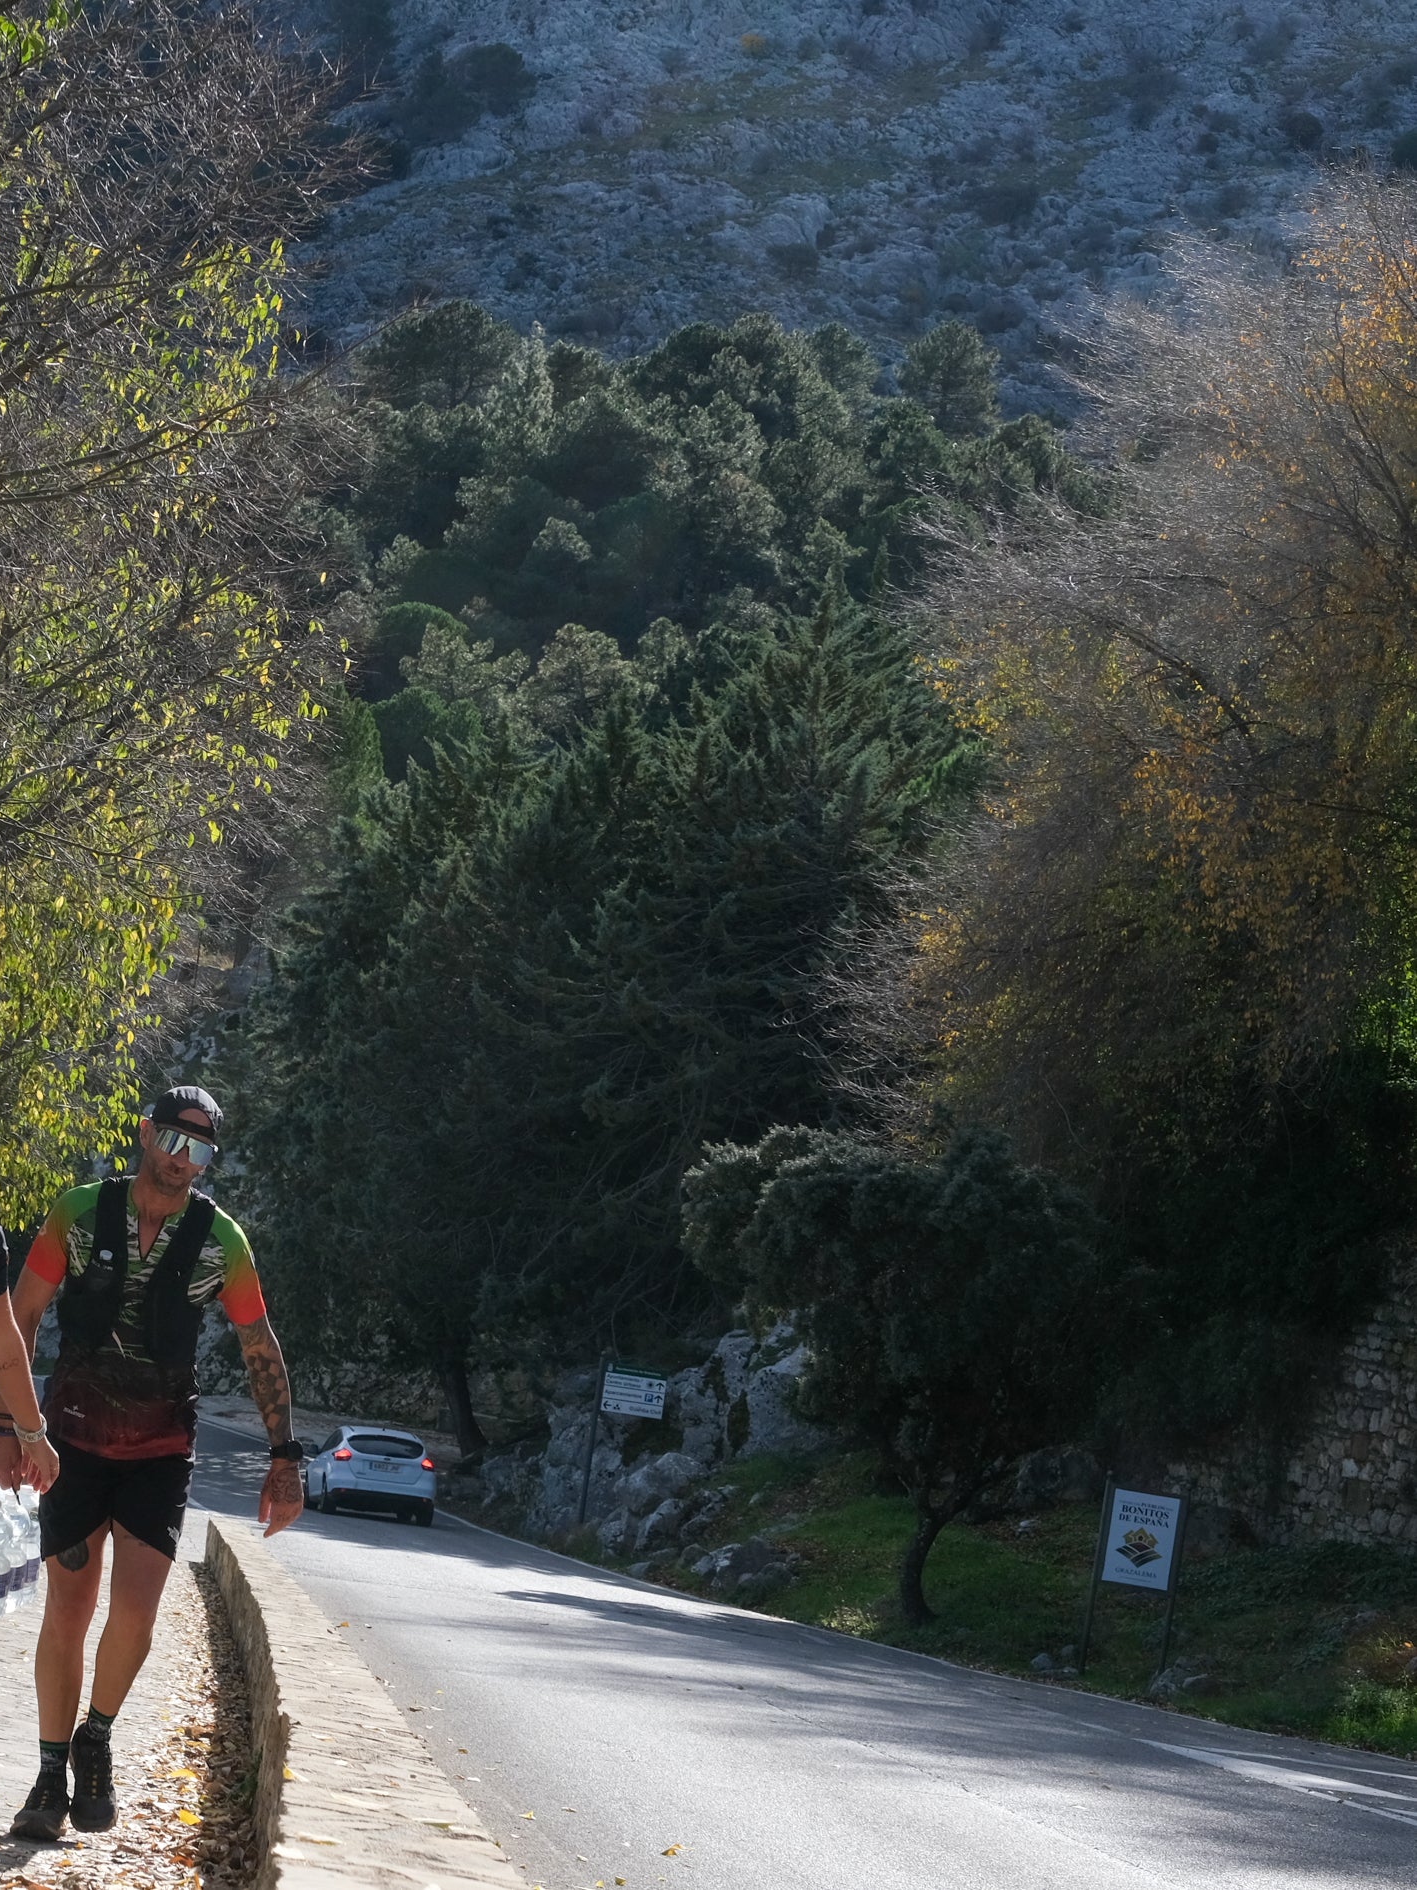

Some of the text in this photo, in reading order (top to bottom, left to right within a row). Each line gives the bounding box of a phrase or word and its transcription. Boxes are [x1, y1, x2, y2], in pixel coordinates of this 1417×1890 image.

[1122, 1504, 1170, 1520] BONITOS
[1119, 1513, 1170, 1528] DE ESPAÑA
[1115, 1567, 1157, 1578] GRAZALEMA
